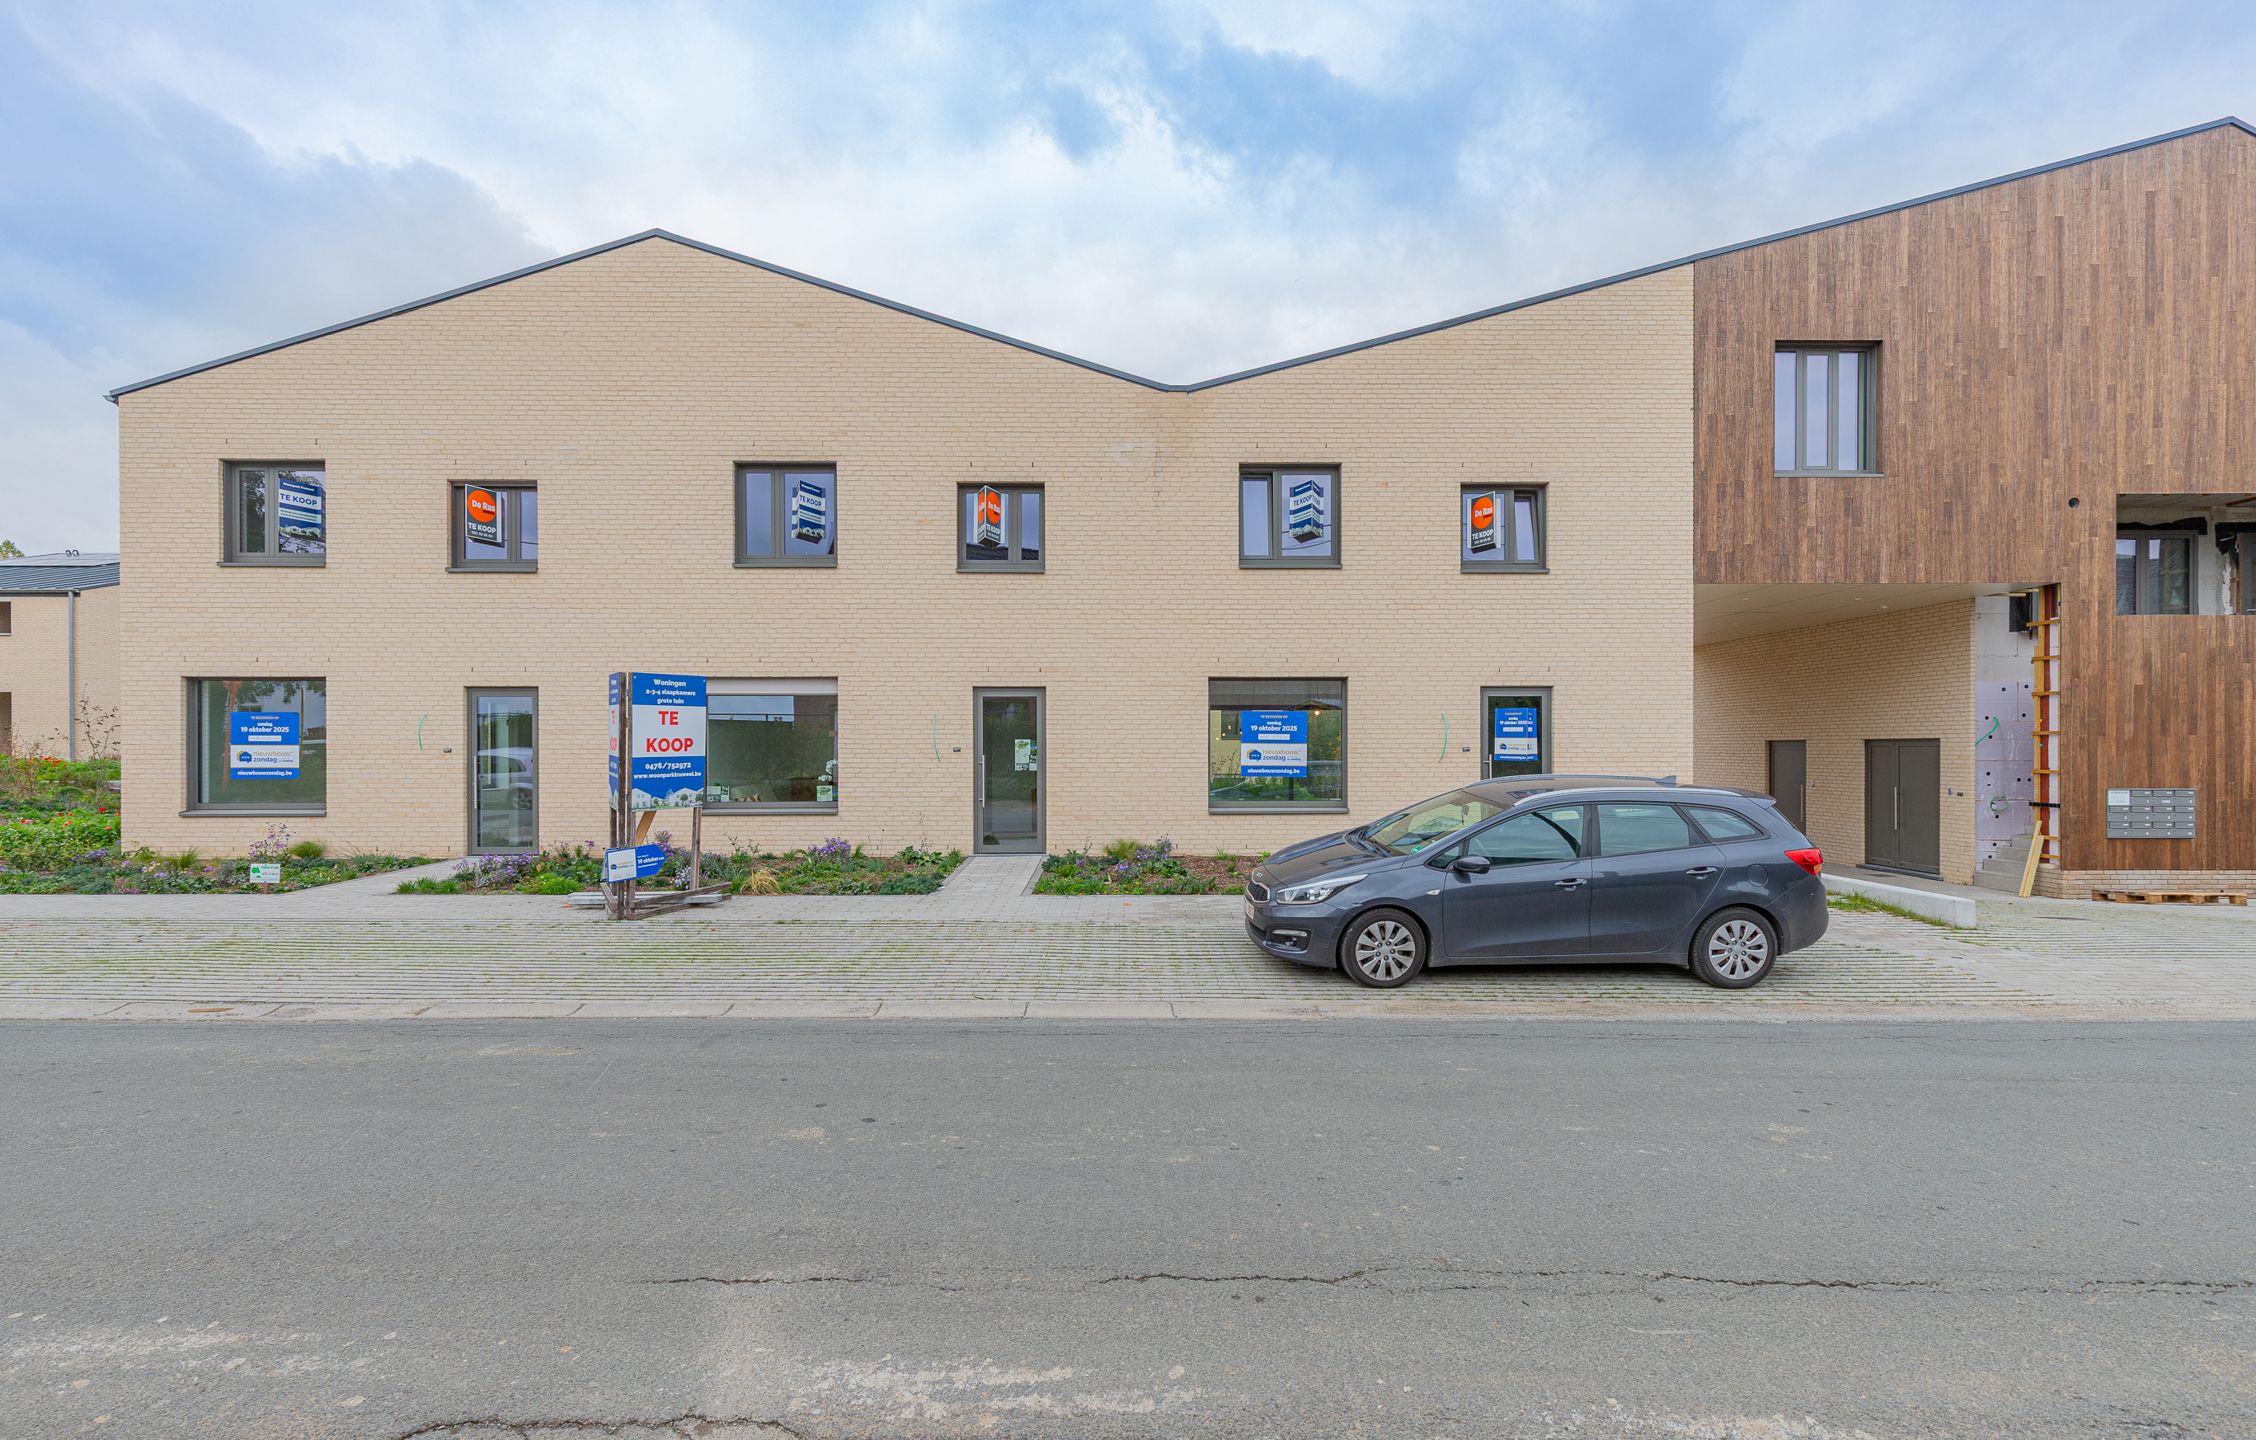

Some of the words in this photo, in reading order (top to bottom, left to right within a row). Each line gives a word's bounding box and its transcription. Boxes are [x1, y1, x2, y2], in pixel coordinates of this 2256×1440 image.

[280, 493, 290, 501] TE
[292, 496, 317, 506] KOOP
[807, 497, 821, 506] KOOP
[1300, 494, 1312, 504] KOOP
[472, 500, 481, 508] De
[483, 502, 495, 512] Ras
[468, 522, 476, 530] TE
[478, 524, 496, 533] KOOP
[1479, 529, 1493, 538] KOOP
[653, 679, 686, 688] Woningen
[658, 711, 679, 725] TE
[646, 738, 694, 752] KOOP
[645, 762, 691, 770] 0476/752972
